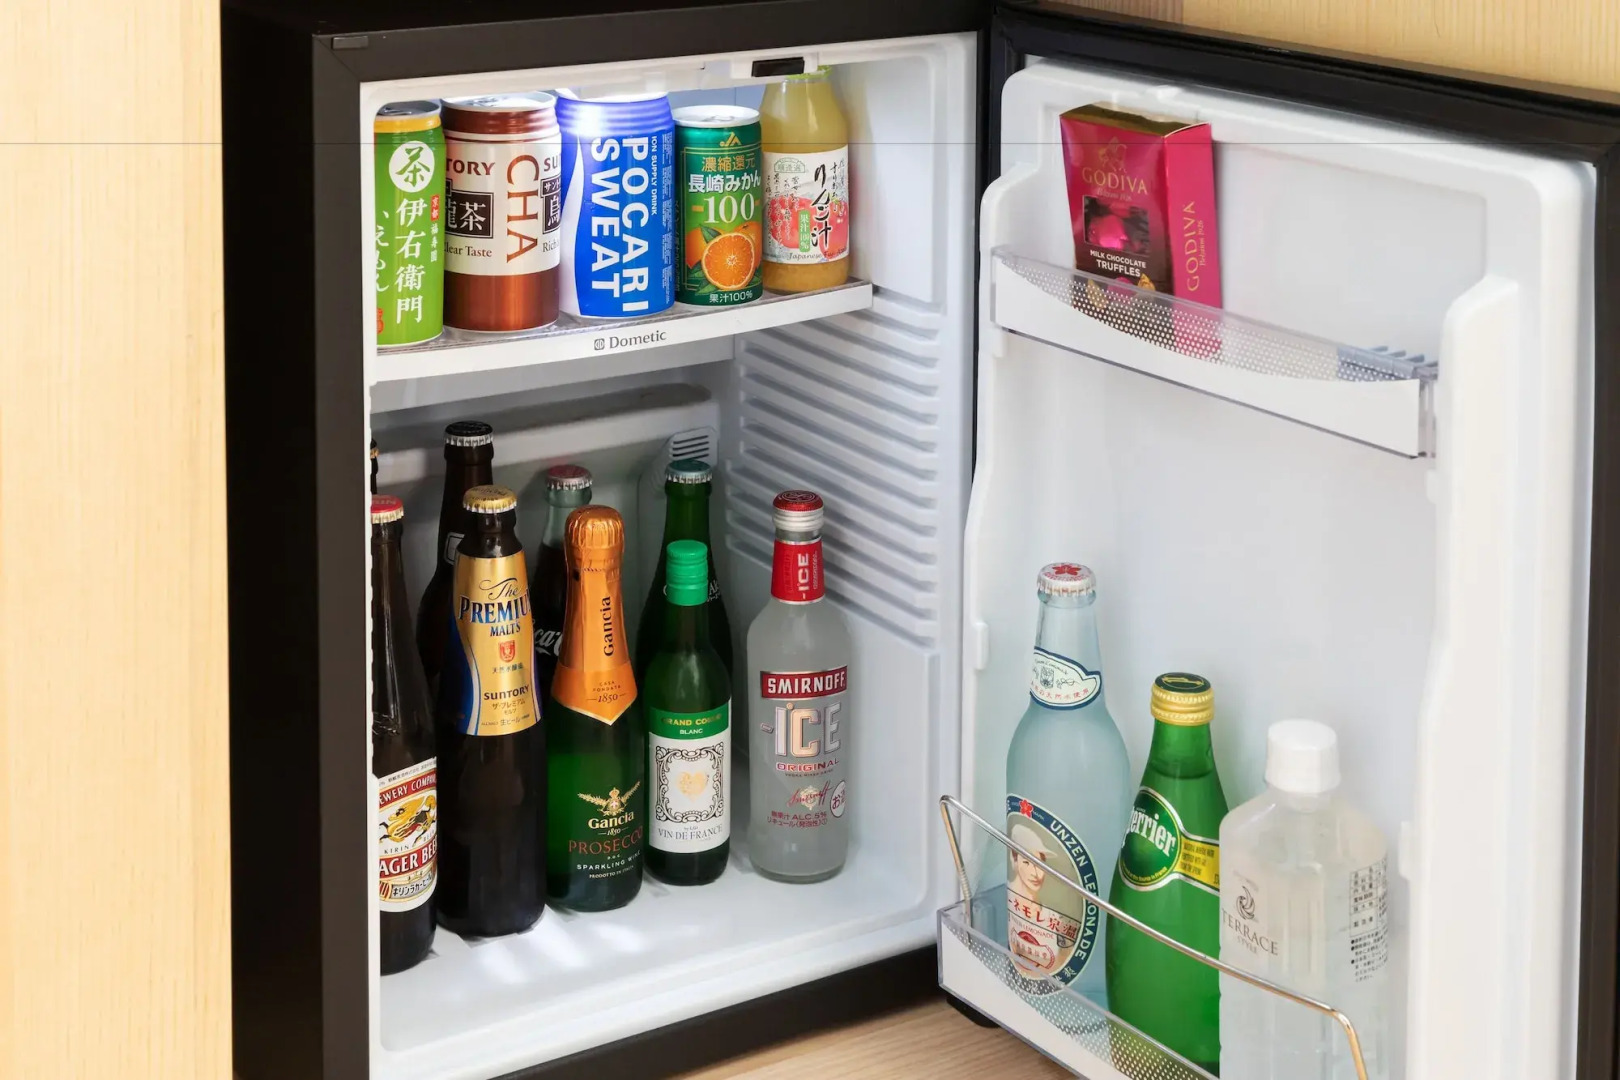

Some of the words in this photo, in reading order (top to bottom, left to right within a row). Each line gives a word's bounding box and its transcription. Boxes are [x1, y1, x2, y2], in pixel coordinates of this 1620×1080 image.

[398, 146, 431, 188] 茶
[701, 152, 756, 172] 濃縮還元
[688, 169, 761, 194] 長崎みかん
[1082, 166, 1149, 196] GODIVA
[507, 154, 540, 263] CHA
[590, 138, 621, 298] SWEAT
[810, 163, 832, 249] りんご汁
[622, 137, 649, 312] POCARI
[465, 246, 493, 258] Taste
[1182, 200, 1200, 293] GODIVA
[394, 198, 428, 325] 伊右衛門
[1089, 249, 1106, 260] MILK
[1106, 253, 1147, 269] CHOCOLATE
[1096, 259, 1142, 278] TRUFFLES
[709, 290, 753, 303] 果汁100%
[609, 330, 667, 350] Dometic
[798, 553, 810, 592] ICE
[479, 577, 521, 601] The
[459, 588, 531, 624] PREMIU
[490, 623, 522, 637] MALT'S
[600, 595, 616, 657] Gancia
[767, 671, 846, 695] SMIRNOFF
[597, 693, 619, 704] 1850
[679, 728, 704, 736] BLANC
[774, 701, 842, 759] ICE
[775, 757, 840, 773] ORIGINAL
[588, 811, 635, 829] Gancia
[658, 827, 673, 839] VIN
[675, 830, 688, 841] DE
[690, 823, 723, 841] FRANCE
[384, 844, 410, 855] KIRIN
[1049, 820, 1089, 867] UNZEN
[576, 859, 626, 870] SPARKLING
[1221, 908, 1279, 956] TERRACE
